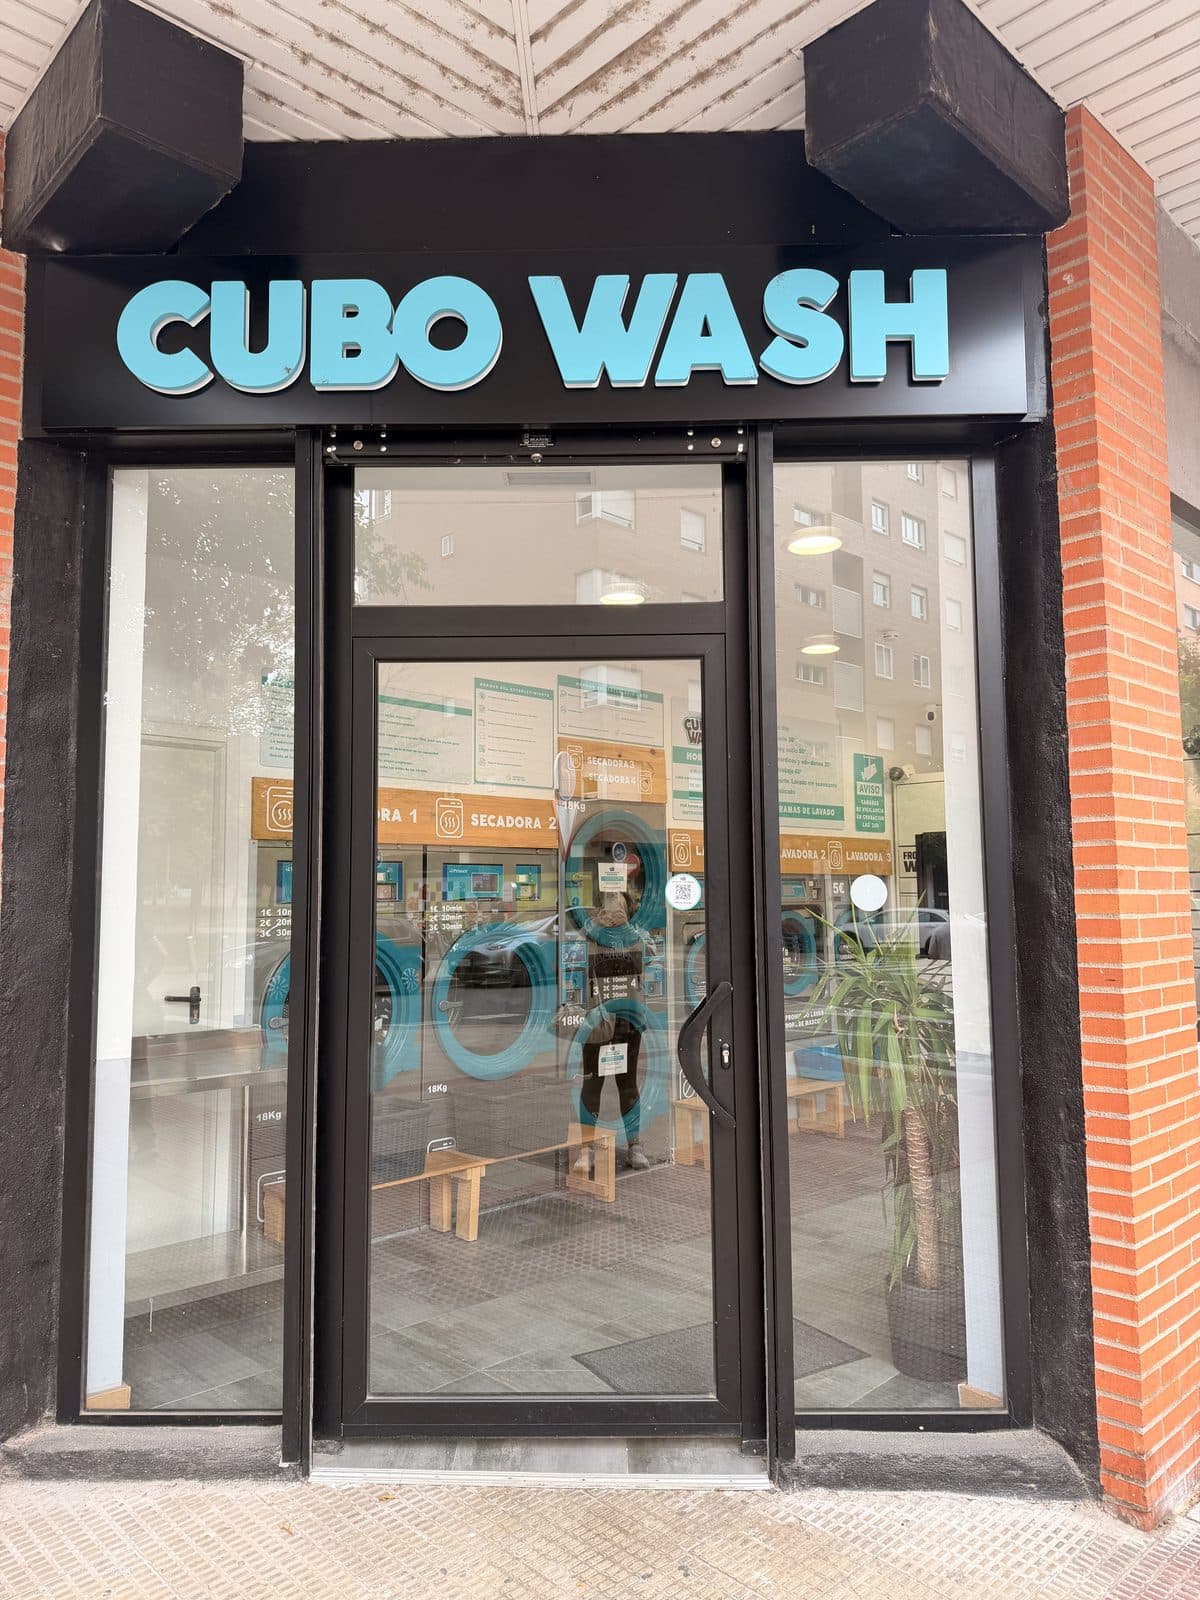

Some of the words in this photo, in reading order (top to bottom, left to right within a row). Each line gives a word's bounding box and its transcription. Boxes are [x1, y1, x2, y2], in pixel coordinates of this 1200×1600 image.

[116, 275, 503, 396] CUBO
[527, 268, 950, 389] WASH
[684, 719, 702, 731] CU
[859, 783, 880, 794] AVISO
[409, 808, 417, 824] 1
[803, 806, 810, 815] DE
[812, 807, 835, 817] LAVADO
[471, 813, 542, 829] SECADORA
[549, 816, 557, 830] 2
[780, 848, 819, 861] AVADORA
[820, 849, 827, 860] 2
[846, 851, 883, 862] LAVADORA
[886, 852, 892, 863] 3
[832, 882, 845, 894] 5€
[261, 909, 272, 917] 1€
[442, 903, 463, 912] 10min
[441, 913, 463, 921] 20min
[260, 919, 272, 927] 2€
[441, 922, 463, 930] 30min
[259, 930, 272, 938] 3€
[612, 975, 628, 983] 10min
[630, 978, 637, 988] 4
[593, 986, 599, 996] 3
[427, 1083, 448, 1094] 18Kg
[256, 1110, 282, 1122] 18Kg
